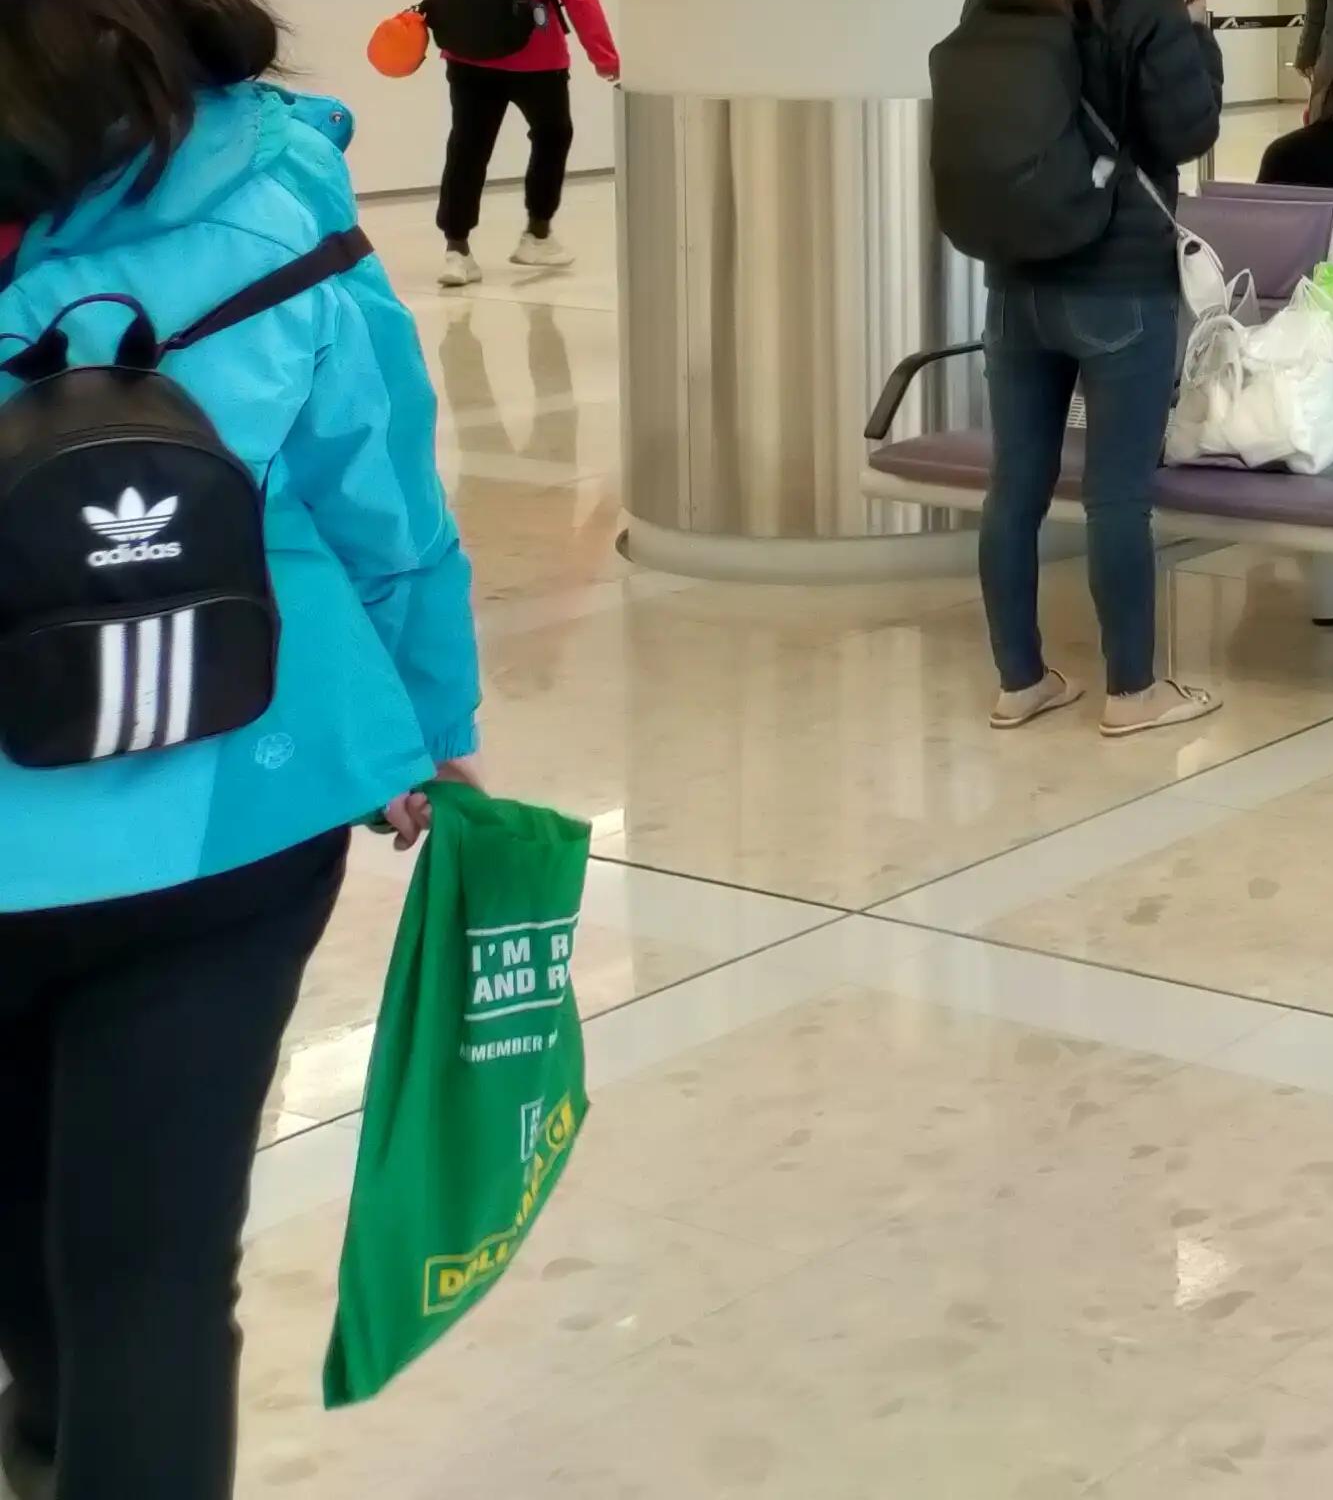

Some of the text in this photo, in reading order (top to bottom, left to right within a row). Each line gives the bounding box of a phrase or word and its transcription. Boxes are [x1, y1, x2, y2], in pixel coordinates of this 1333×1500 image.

[88, 541, 182, 567] adidas
[471, 937, 531, 972] I'M
[472, 967, 536, 1004] AND
[460, 1035, 543, 1062] MEMBER
